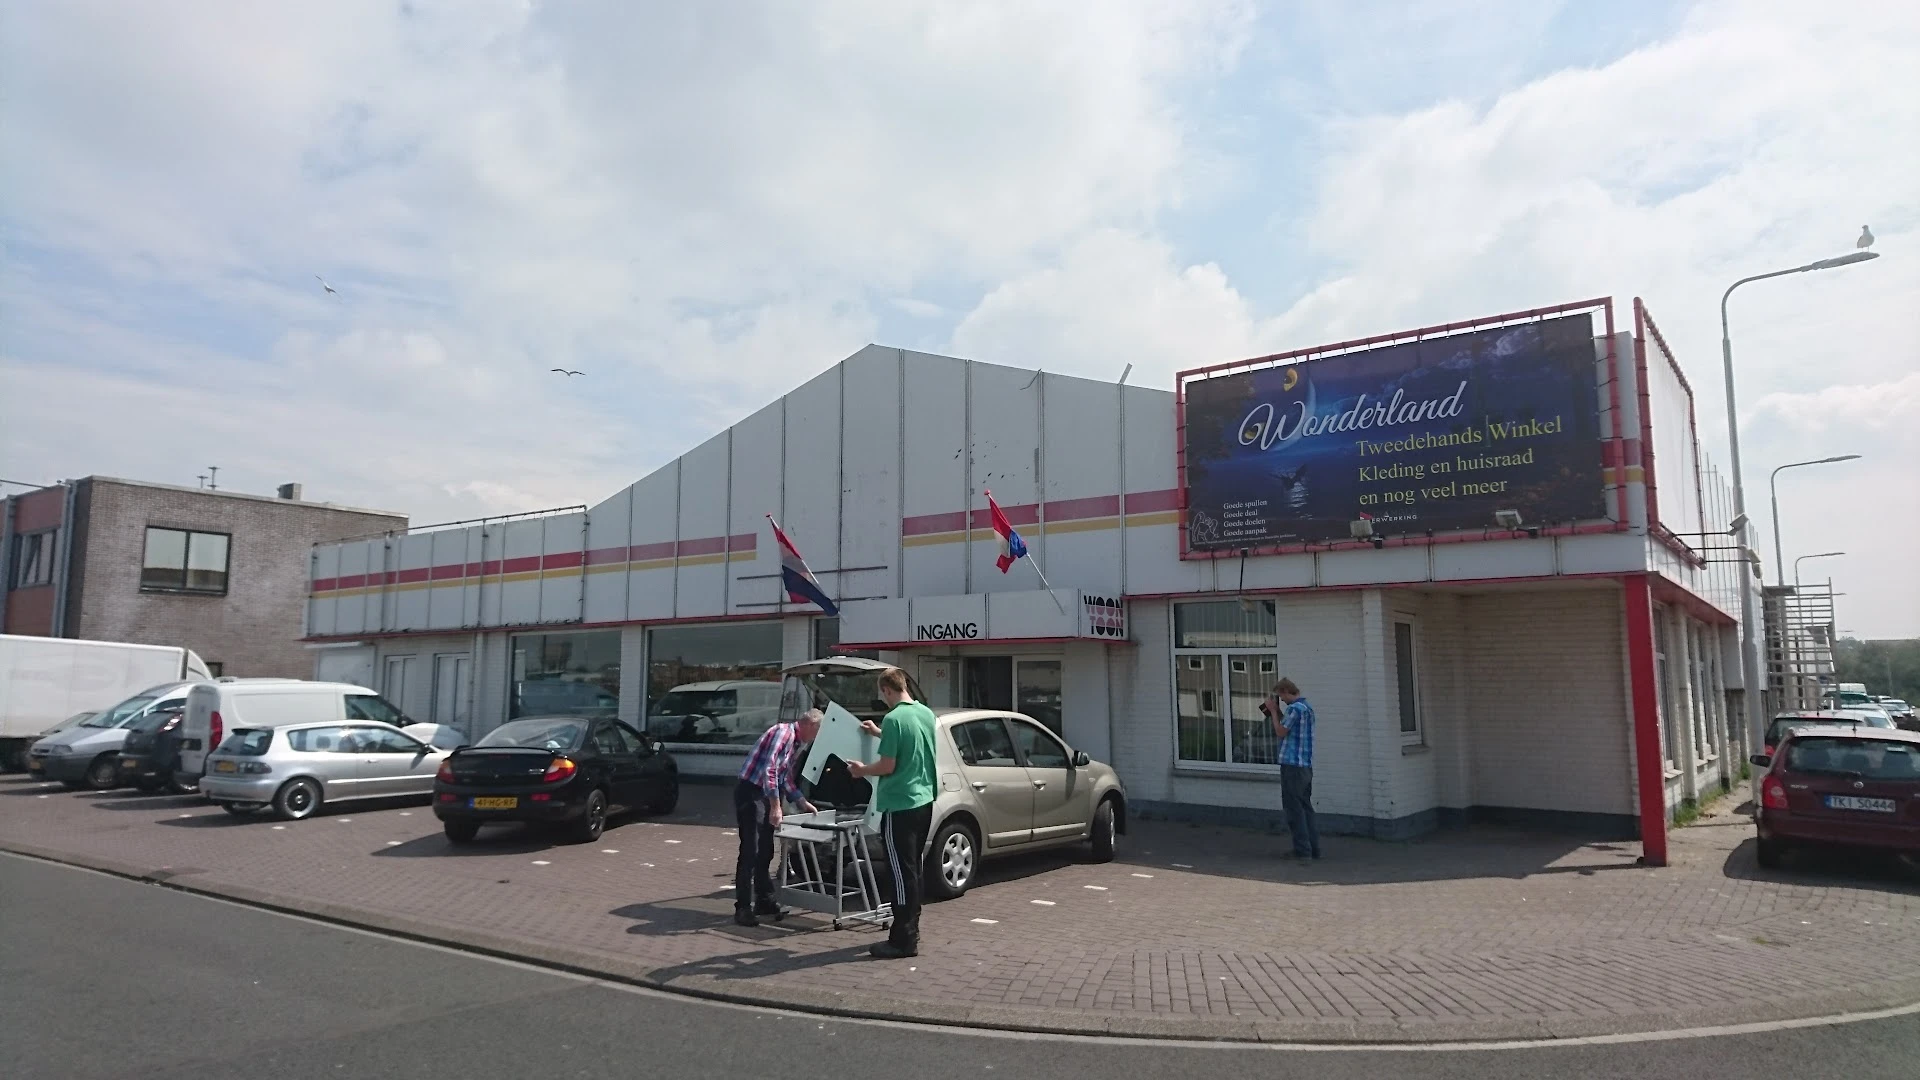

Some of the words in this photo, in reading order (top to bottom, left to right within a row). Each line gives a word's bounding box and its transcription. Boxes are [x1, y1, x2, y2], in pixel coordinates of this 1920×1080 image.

[1238, 381, 1467, 450] Wonderland
[1356, 427, 1482, 456] Tweedehands
[1489, 415, 1561, 439] Winkel
[1359, 462, 1425, 481] Kleding
[1430, 462, 1450, 473] en
[1457, 448, 1534, 471] huisraad
[1359, 494, 1378, 505] en
[1384, 489, 1415, 504] nog
[1421, 482, 1456, 498] veel
[1463, 480, 1508, 495] meer
[1245, 500, 1267, 508] spullen
[1245, 509, 1258, 517] deal
[1245, 518, 1266, 526] doelen
[1371, 514, 1417, 524] ERWERKING
[1245, 527, 1267, 535] aanpak
[1084, 595, 1123, 617] WOON
[917, 622, 978, 640] INGANG
[1090, 615, 1123, 637] TOON
[936, 669, 946, 678] 56
